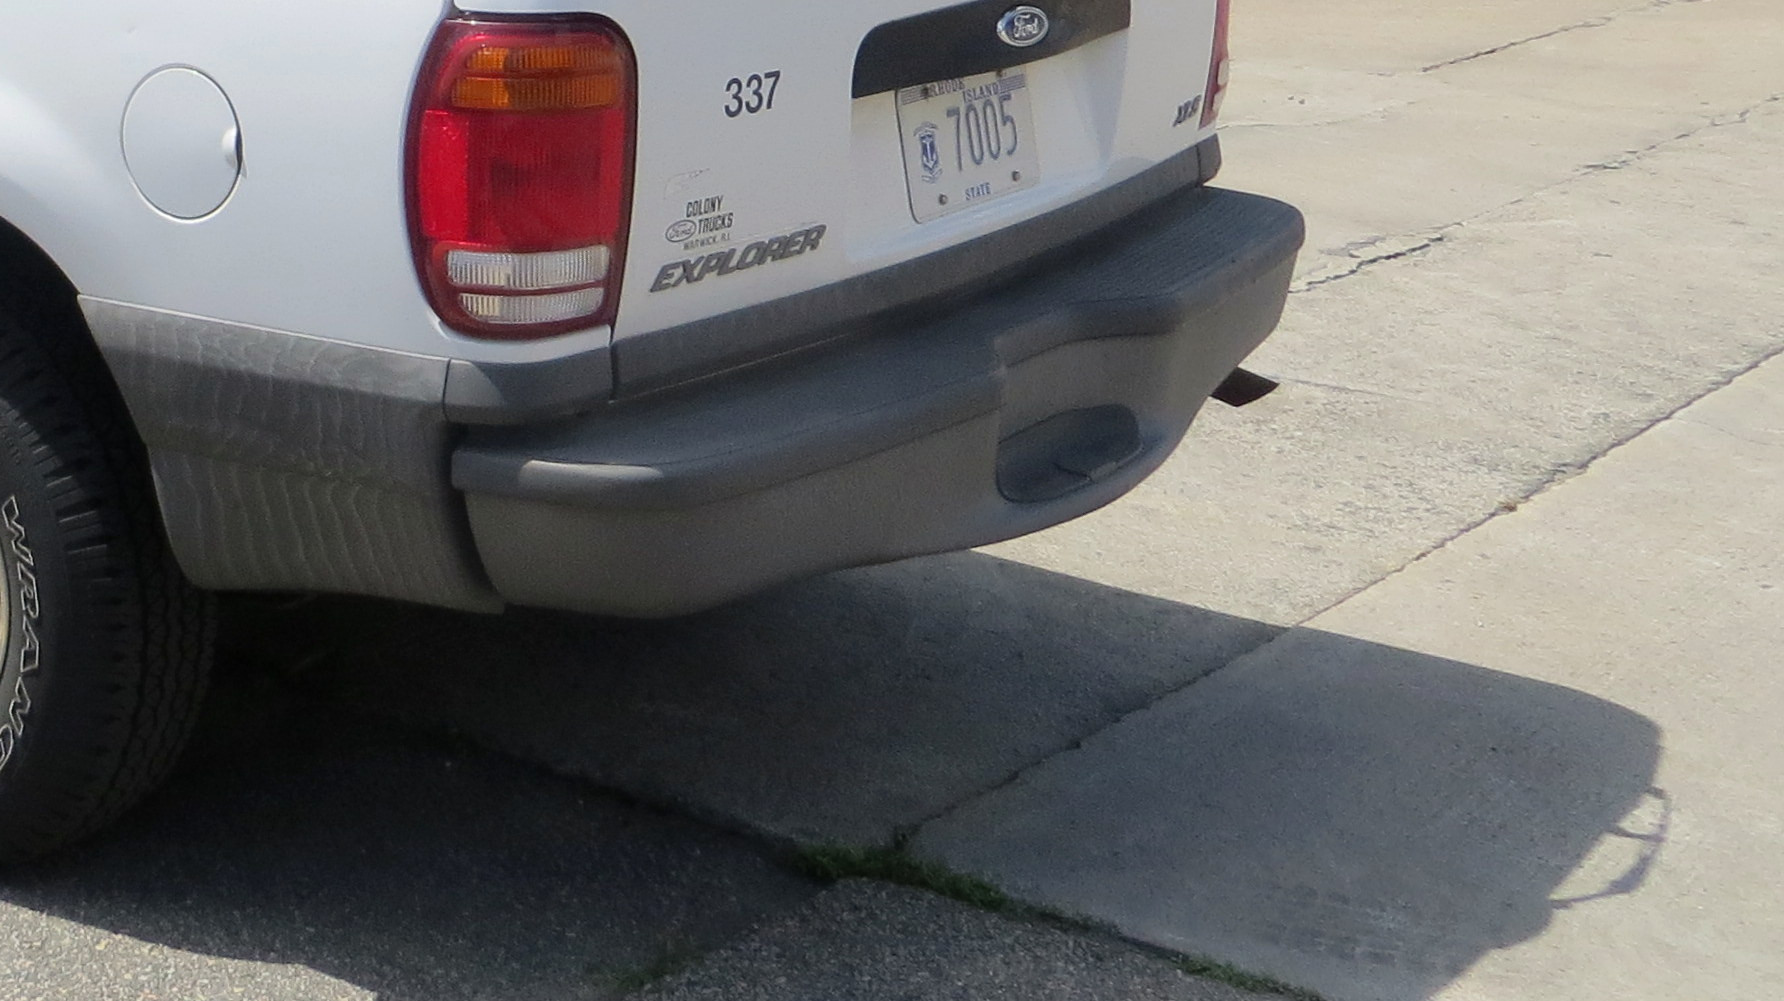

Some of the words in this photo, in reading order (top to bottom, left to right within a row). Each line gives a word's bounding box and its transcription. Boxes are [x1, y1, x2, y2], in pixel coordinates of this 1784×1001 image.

[724, 69, 781, 118] 337
[962, 81, 1001, 103] ISLAND
[946, 92, 1018, 172] 7005
[964, 182, 991, 201] STATE
[686, 195, 724, 218] COLONY
[668, 222, 694, 239] Ford
[697, 212, 734, 235] TRUCKS
[650, 224, 828, 293] EXPLORER
